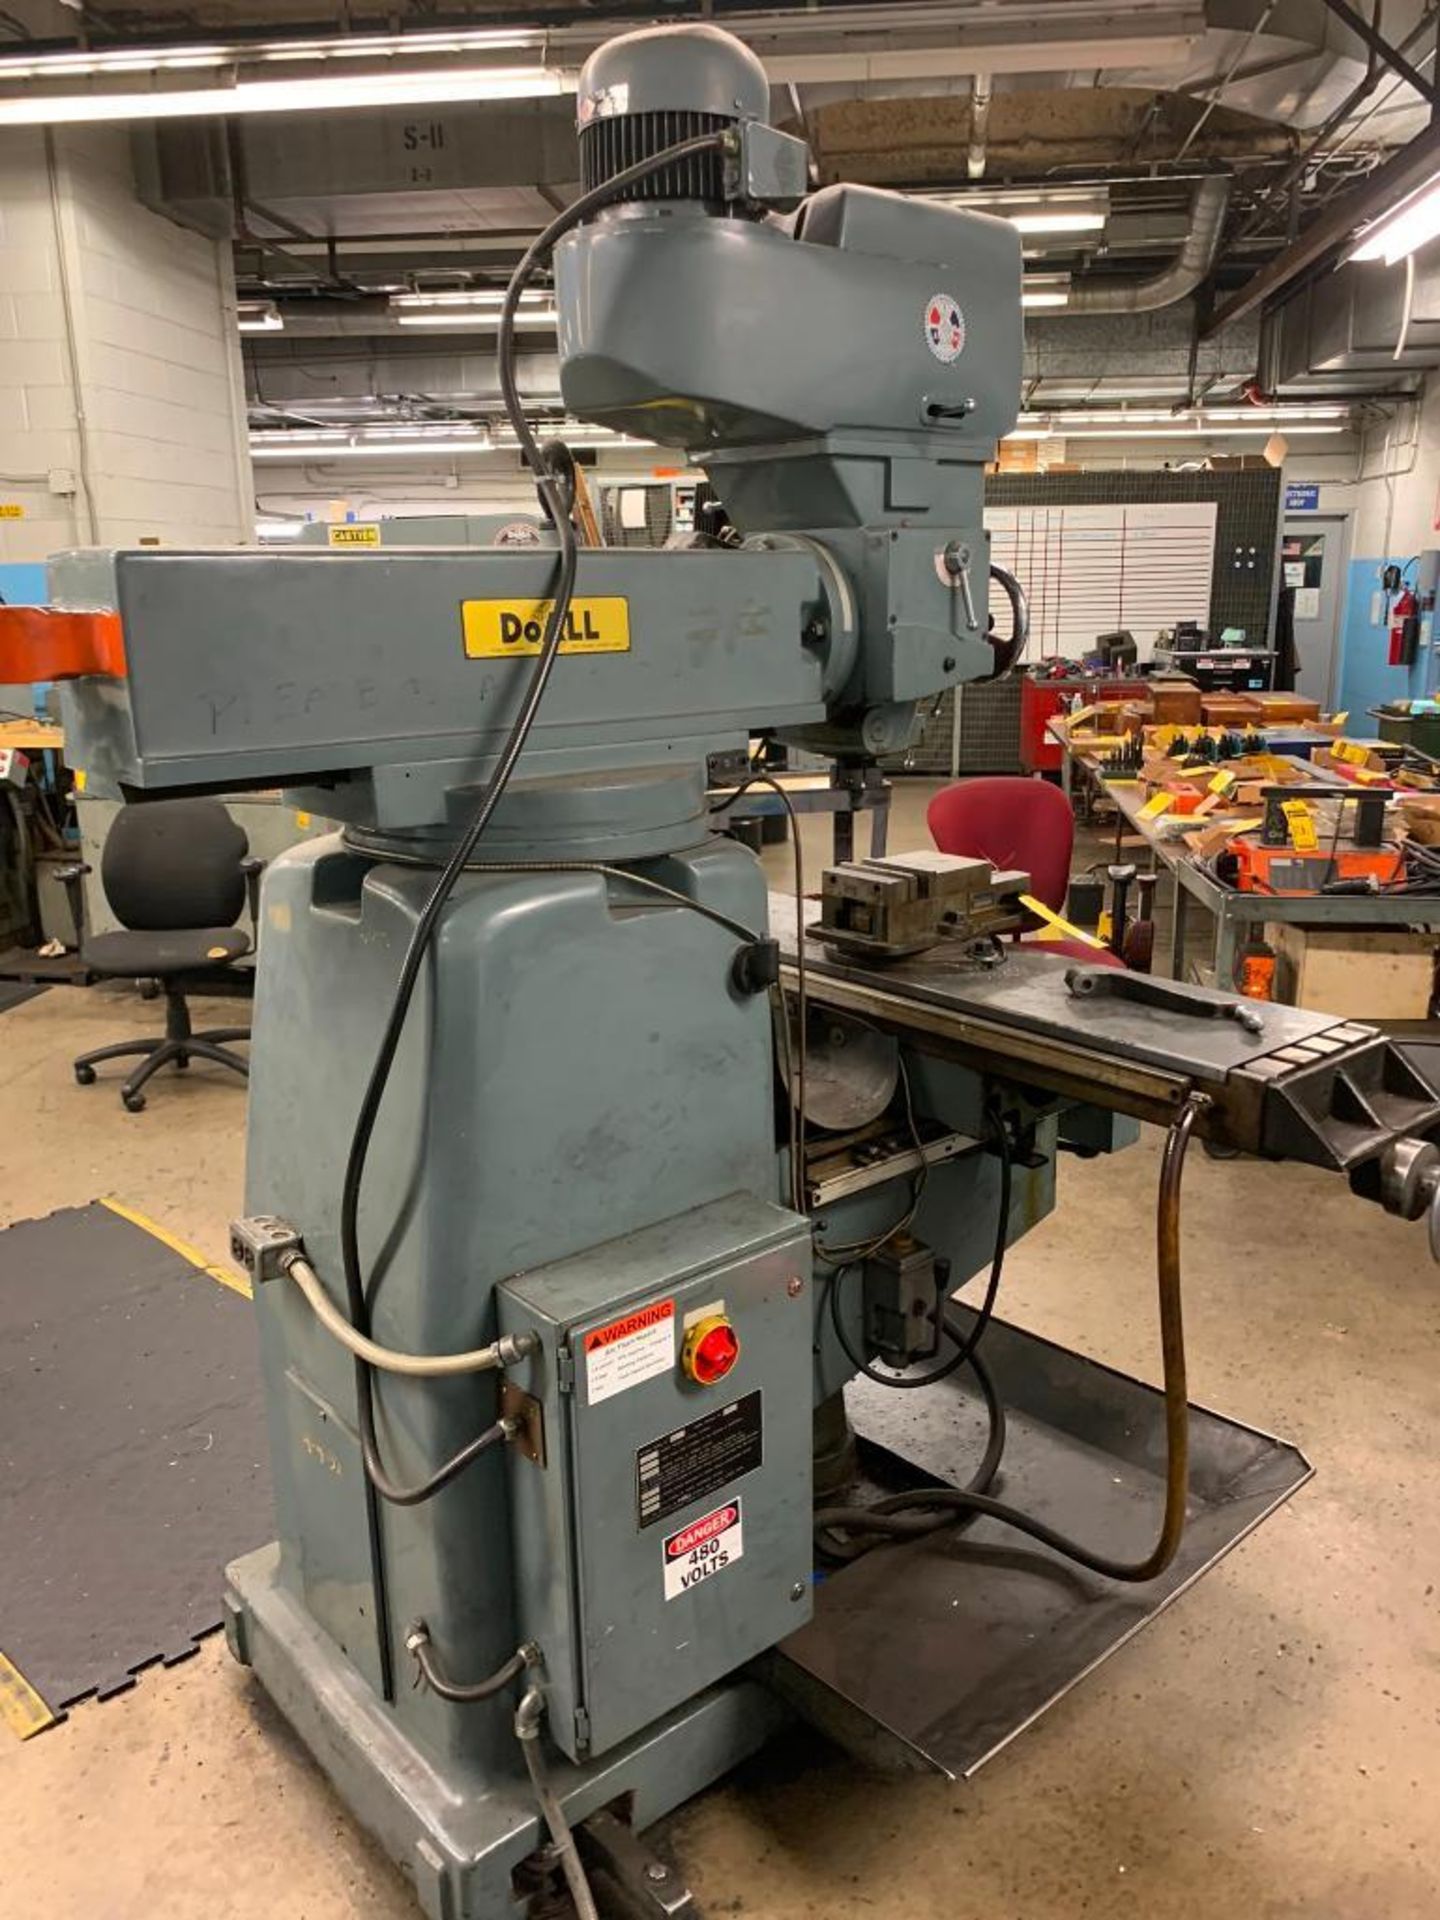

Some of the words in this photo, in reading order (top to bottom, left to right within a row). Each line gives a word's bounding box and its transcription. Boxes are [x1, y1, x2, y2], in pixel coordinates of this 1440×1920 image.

[603, 1303, 672, 1343] WARNING
[675, 1512, 731, 1551] DANGER
[680, 1550, 730, 1589] VOLTS
[688, 1537, 720, 1566] 480
